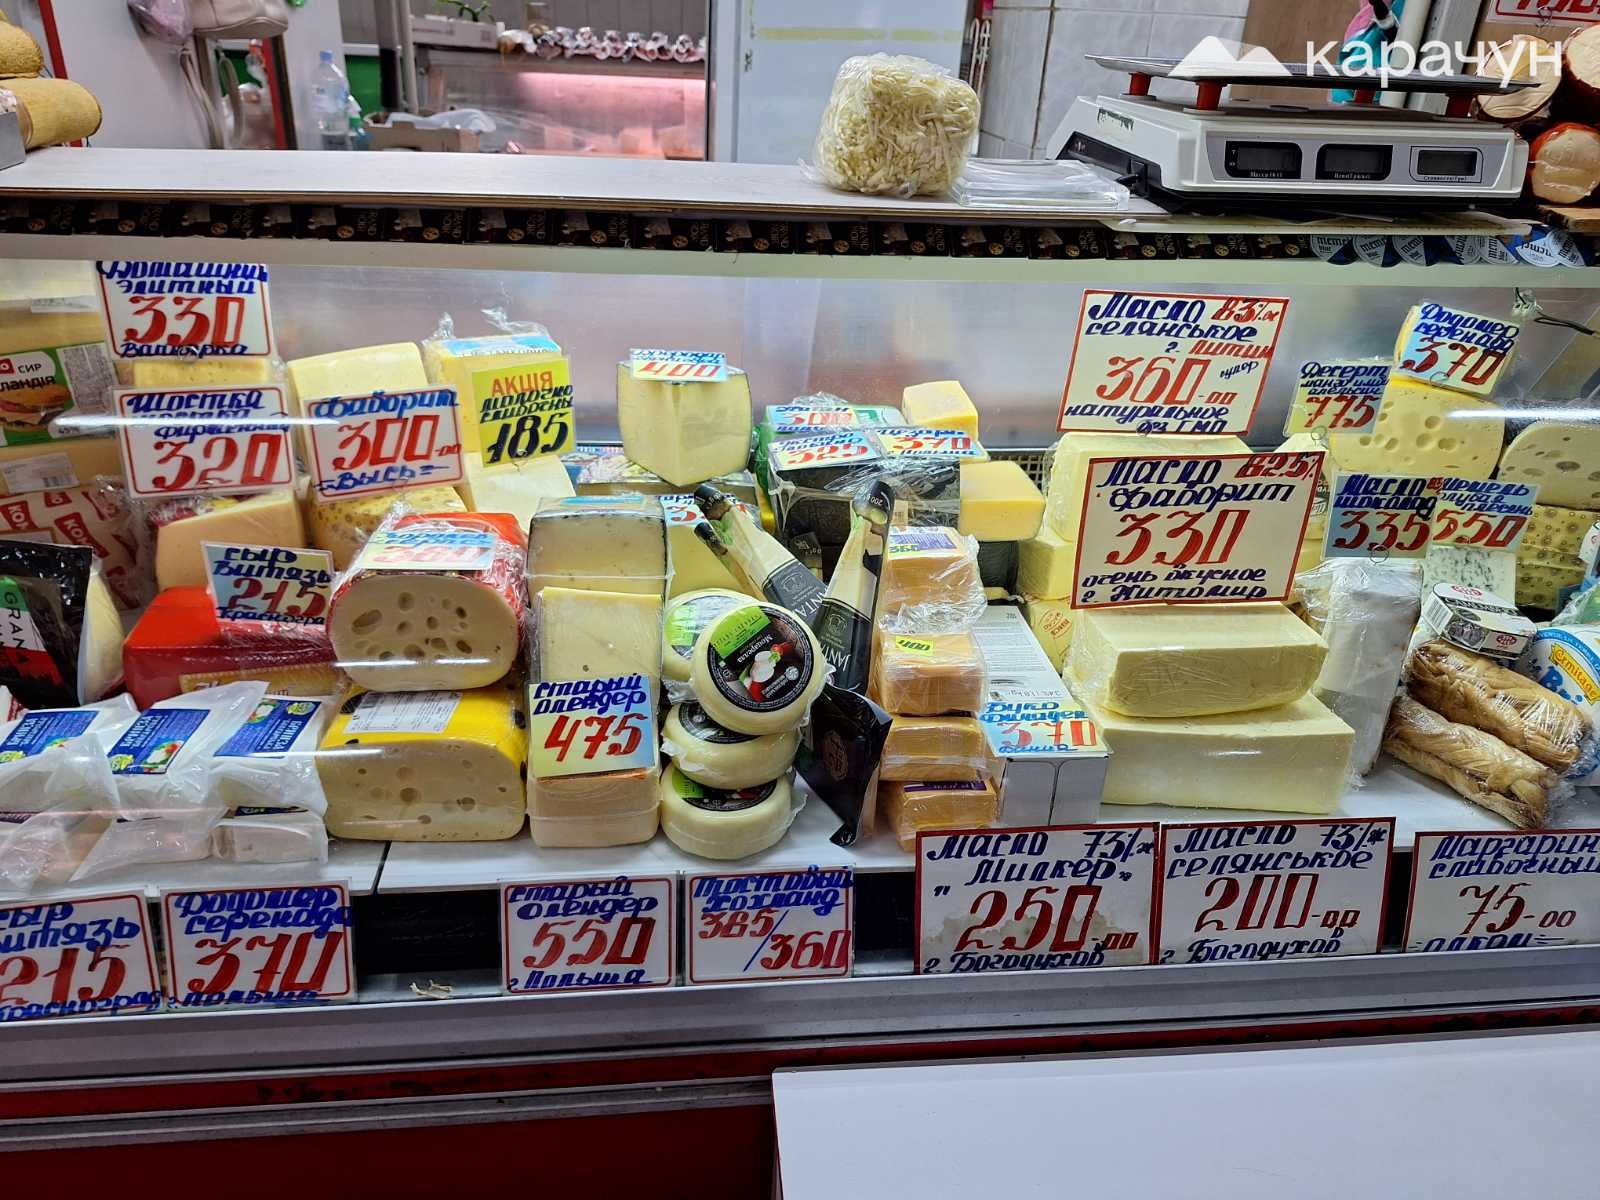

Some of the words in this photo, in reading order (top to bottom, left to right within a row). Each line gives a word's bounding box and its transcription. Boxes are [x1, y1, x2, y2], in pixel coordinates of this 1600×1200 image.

[124, 296, 245, 346] 330
[1088, 292, 1206, 323] Масло
[1398, 336, 1508, 386] 370
[0, 375, 56, 392] ландія
[1304, 394, 1381, 429] 775
[486, 411, 569, 464] 185
[152, 434, 281, 490] 320
[1096, 459, 1222, 488] Масло
[1104, 509, 1251, 566] 330
[1333, 510, 1431, 551] 335
[1432, 509, 1527, 548] 550
[226, 577, 328, 617] 215
[544, 713, 648, 762] 475
[996, 720, 1098, 748] 370
[927, 831, 1049, 861] Масло
[1174, 824, 1298, 853] Масло
[187, 932, 345, 995] 370
[523, 917, 656, 969] 550
[0, 944, 126, 1005] 215
